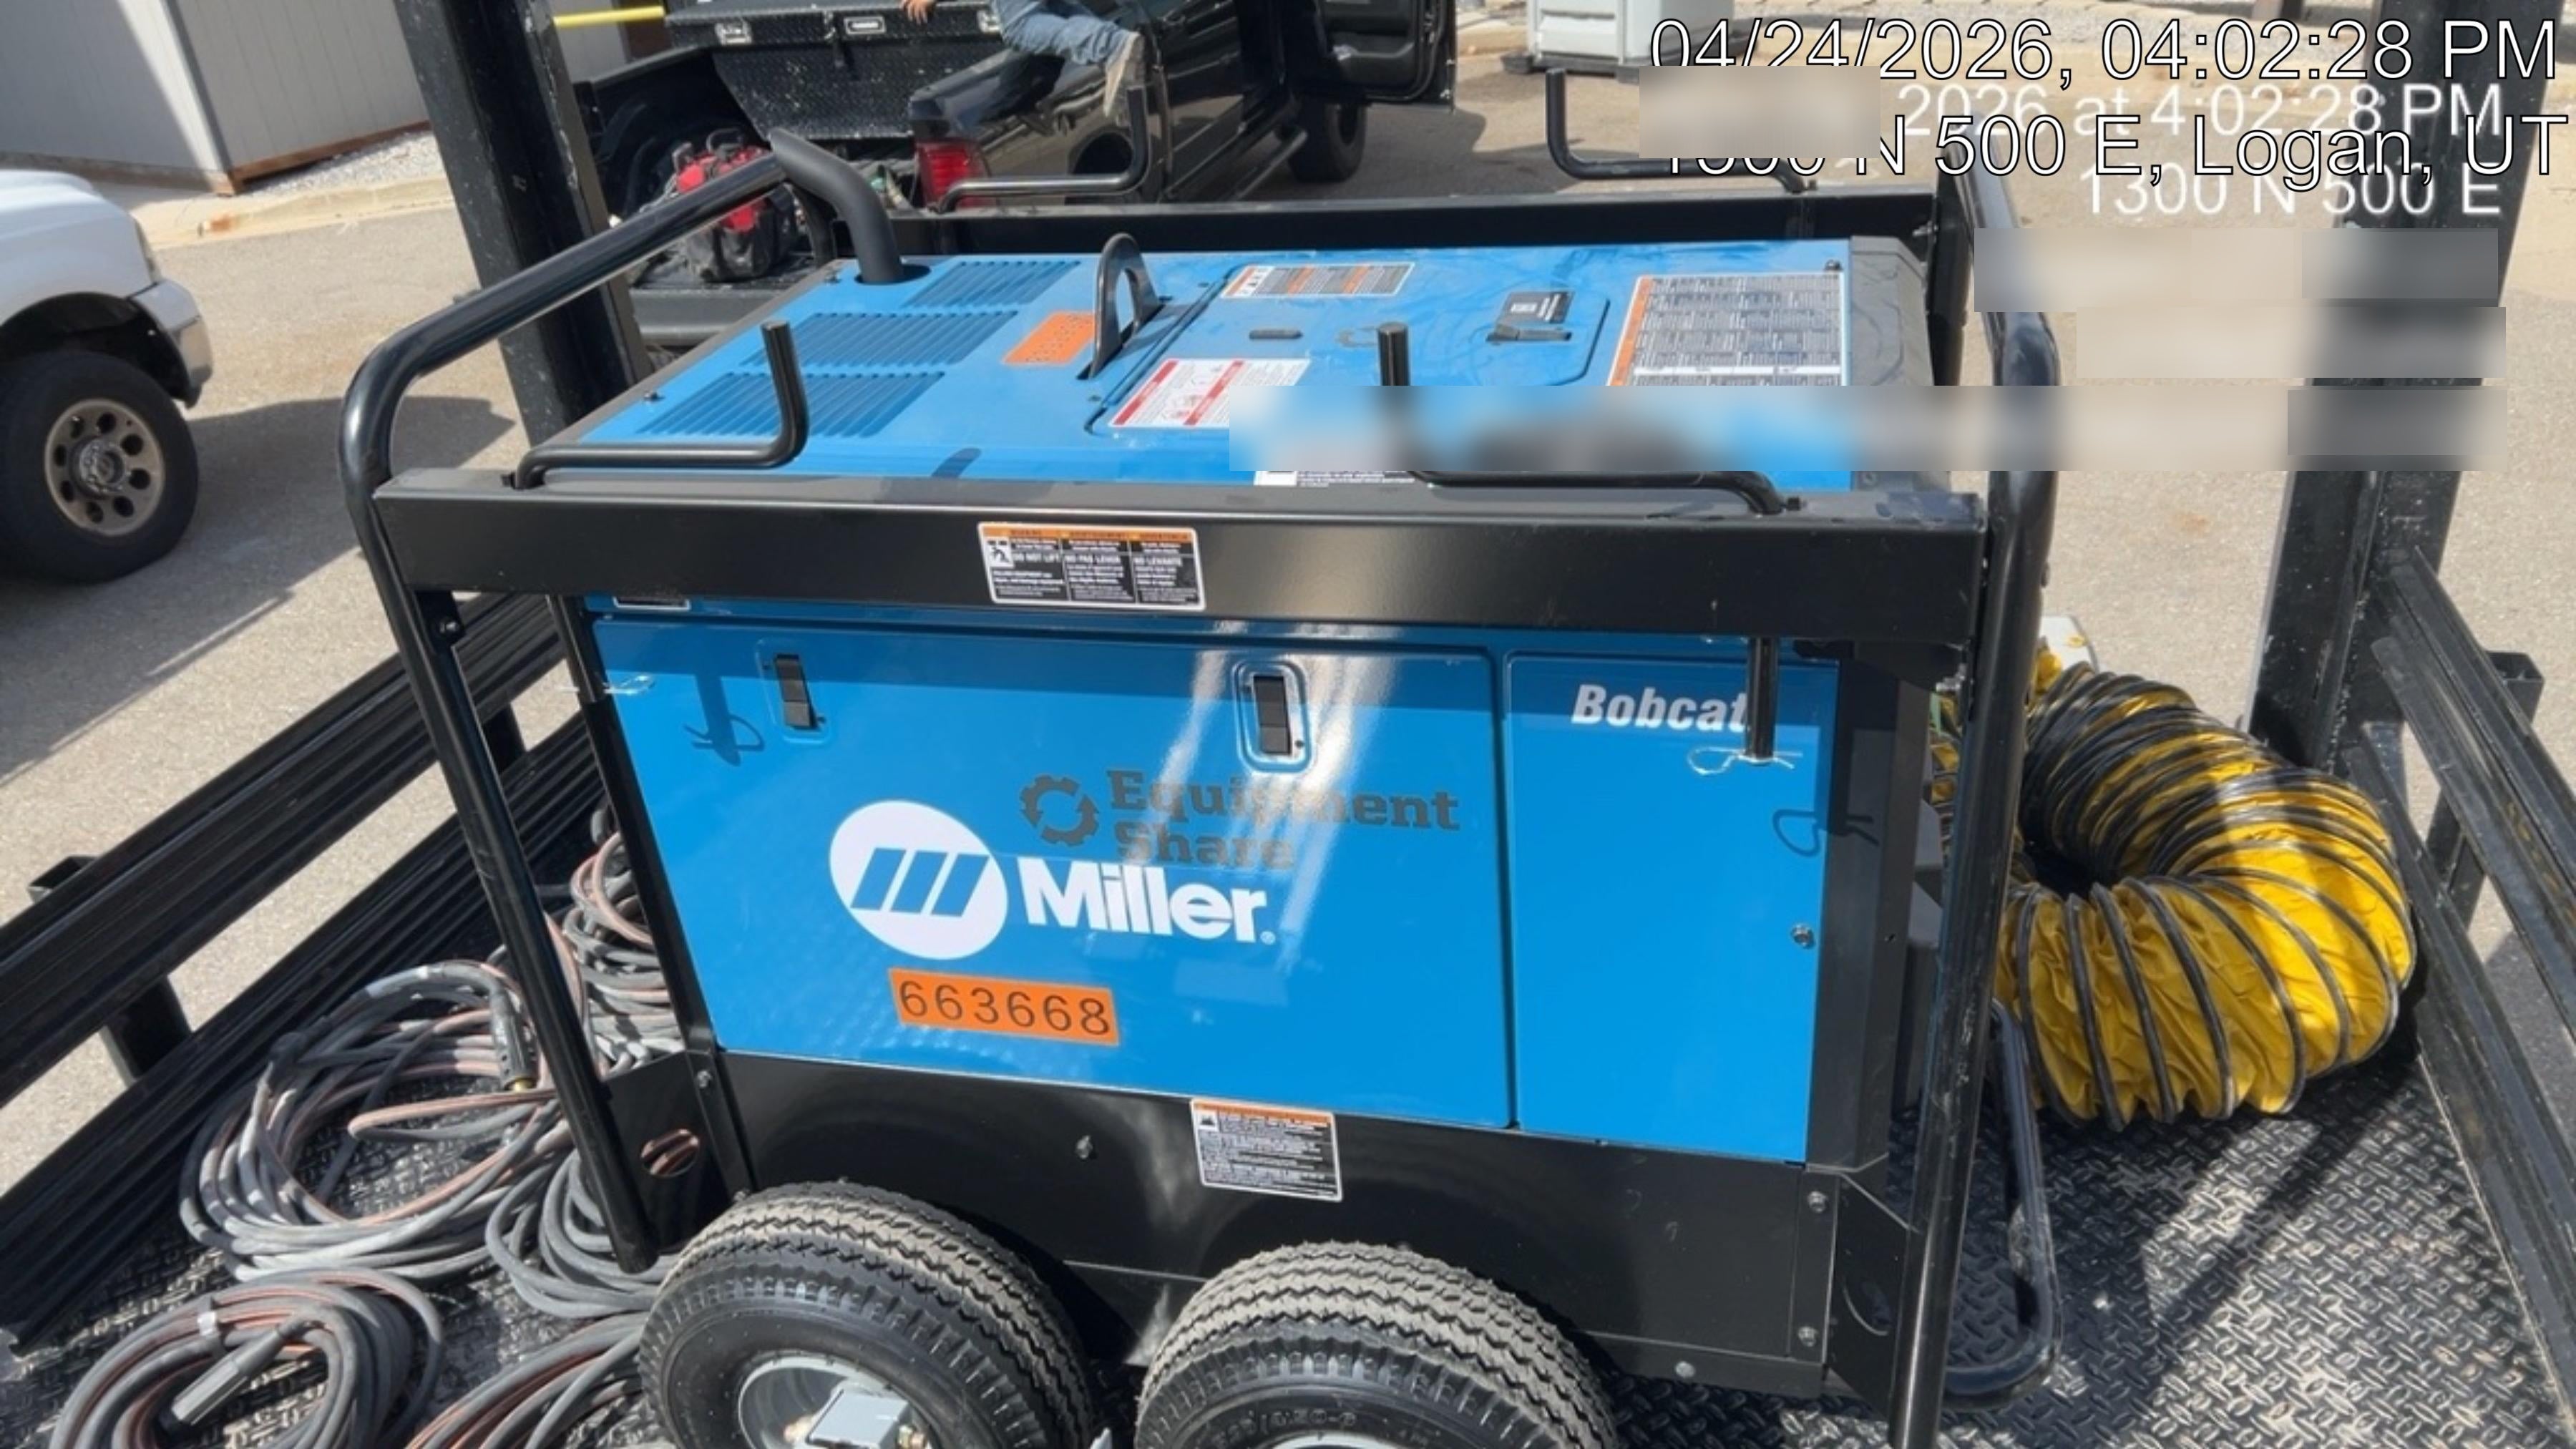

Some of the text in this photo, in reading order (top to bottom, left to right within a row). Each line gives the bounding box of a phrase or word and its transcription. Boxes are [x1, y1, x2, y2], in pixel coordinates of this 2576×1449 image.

[1571, 683, 1751, 733] Bobcat
[1114, 819, 1295, 871] Share
[1017, 856, 1269, 944] Miller
[899, 980, 1112, 1036] 663668
